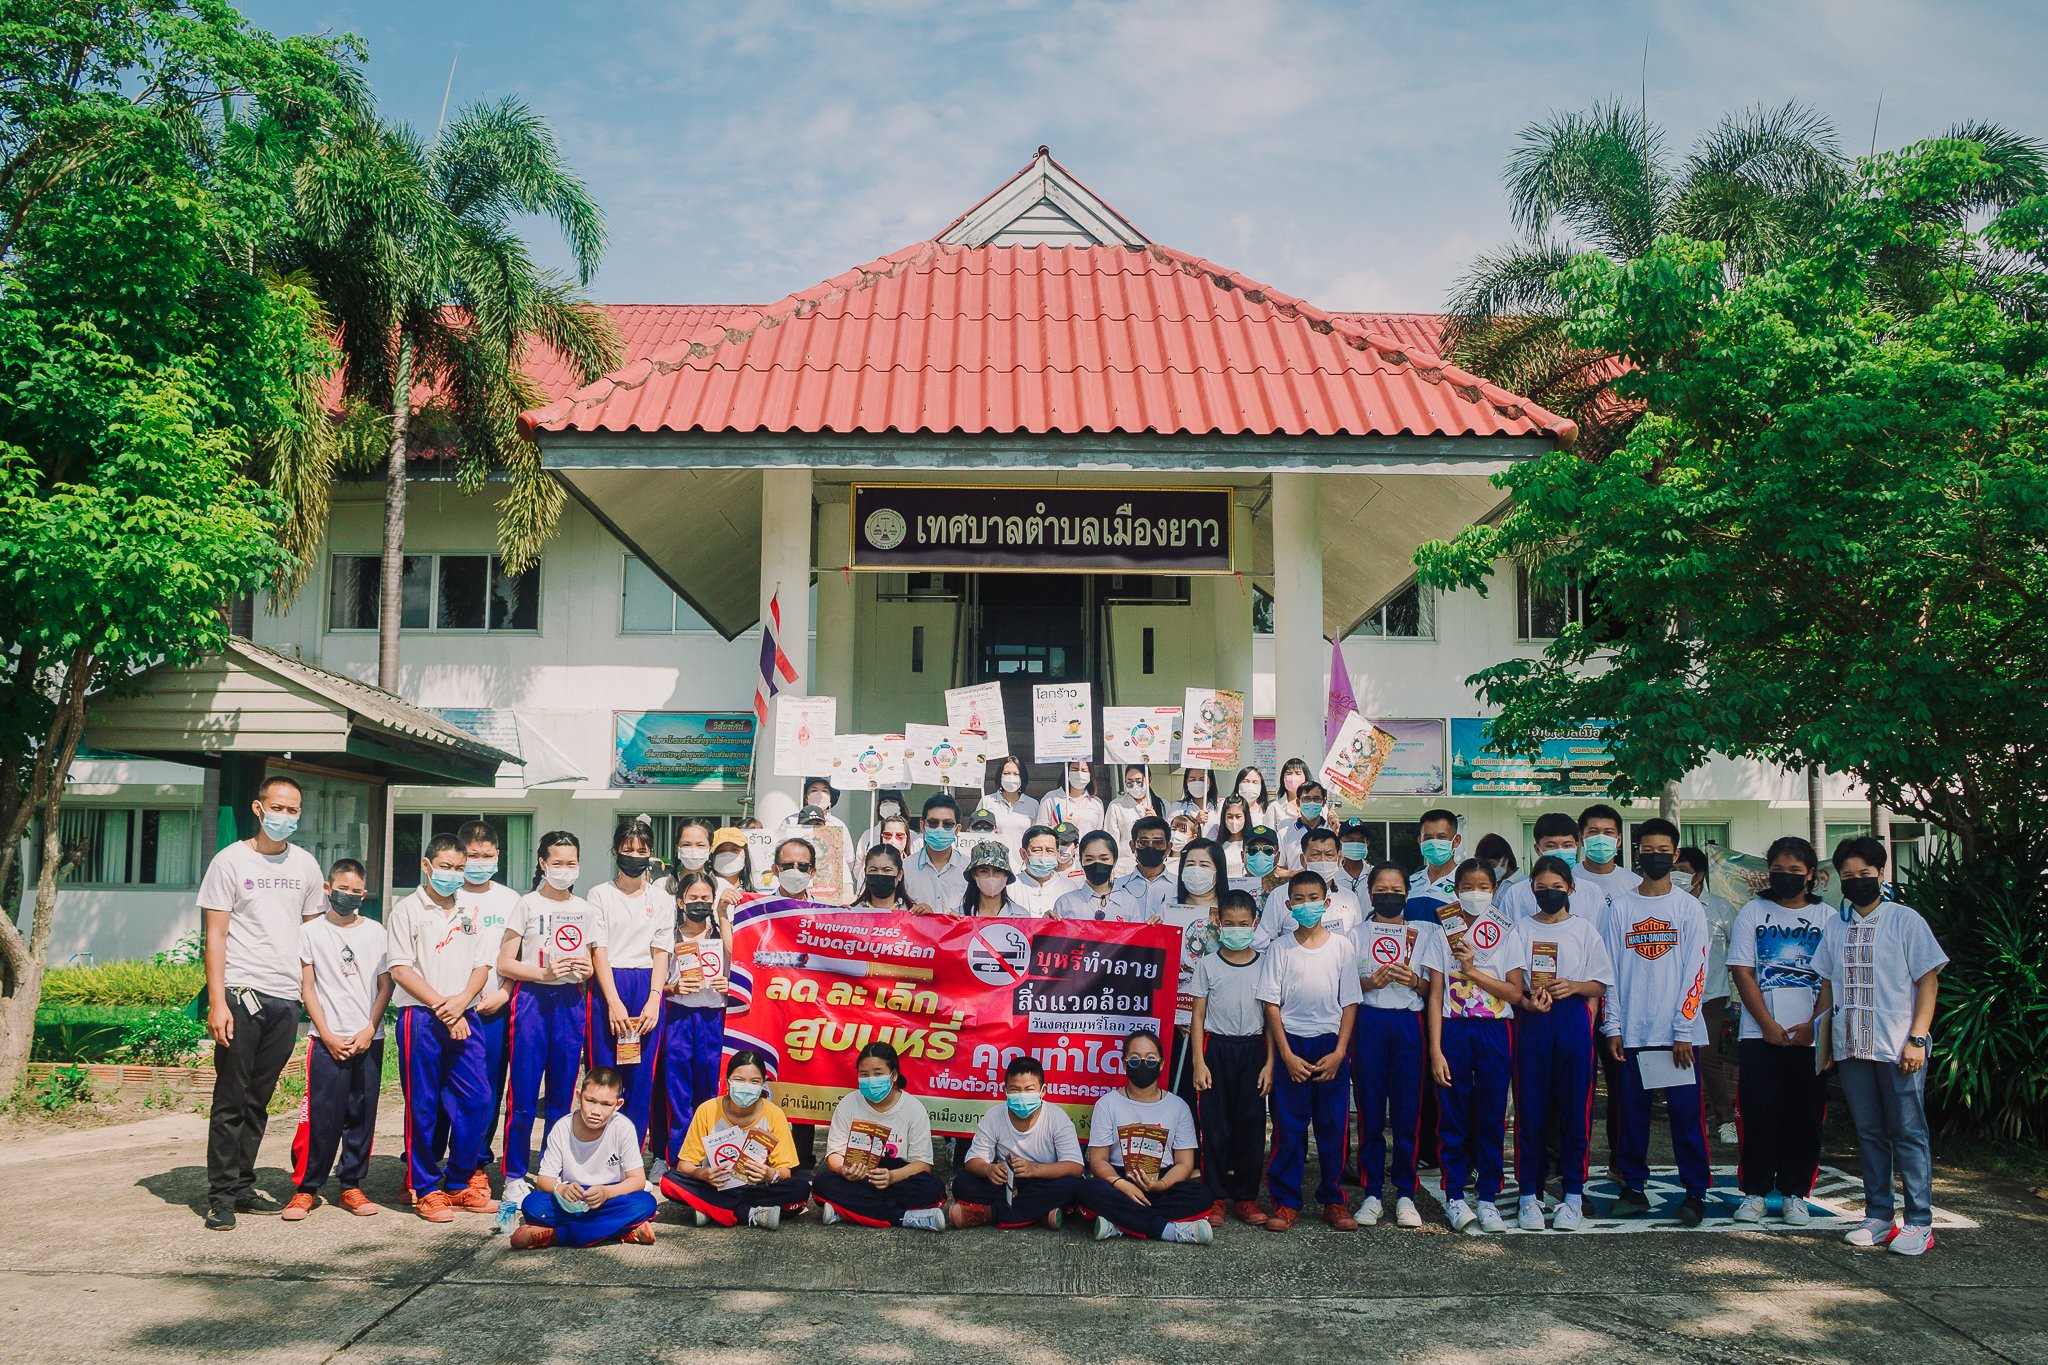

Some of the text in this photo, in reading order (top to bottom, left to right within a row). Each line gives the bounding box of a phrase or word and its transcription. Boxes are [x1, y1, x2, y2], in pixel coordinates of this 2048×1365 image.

[917, 502, 1219, 547] เทศบาลตำบลเมืองยาว
[1036, 688, 1077, 699] โลกร้าว
[1036, 710, 1057, 726] บุหรี่
[748, 832, 772, 845] ร้าว
[257, 878, 301, 890] BE FREE
[799, 919, 901, 938] 31 พฤษภาคม 2565
[1638, 921, 1666, 931] MOTOR
[1756, 914, 1824, 940] อ่างศิล
[796, 930, 936, 959] วันงดสูบบุหรี่โลก
[1628, 932, 1677, 945] HARLEY-DAVIDSON
[1638, 945, 1666, 957] CYCLES
[1037, 943, 1159, 979] บุหรี่ทำลาย
[765, 976, 940, 1015] ลด ละ เลิก
[1018, 983, 1149, 1012] สิ่งแวดล้อม
[1032, 1017, 1126, 1034] วันงดสูบบุหรี่โลก
